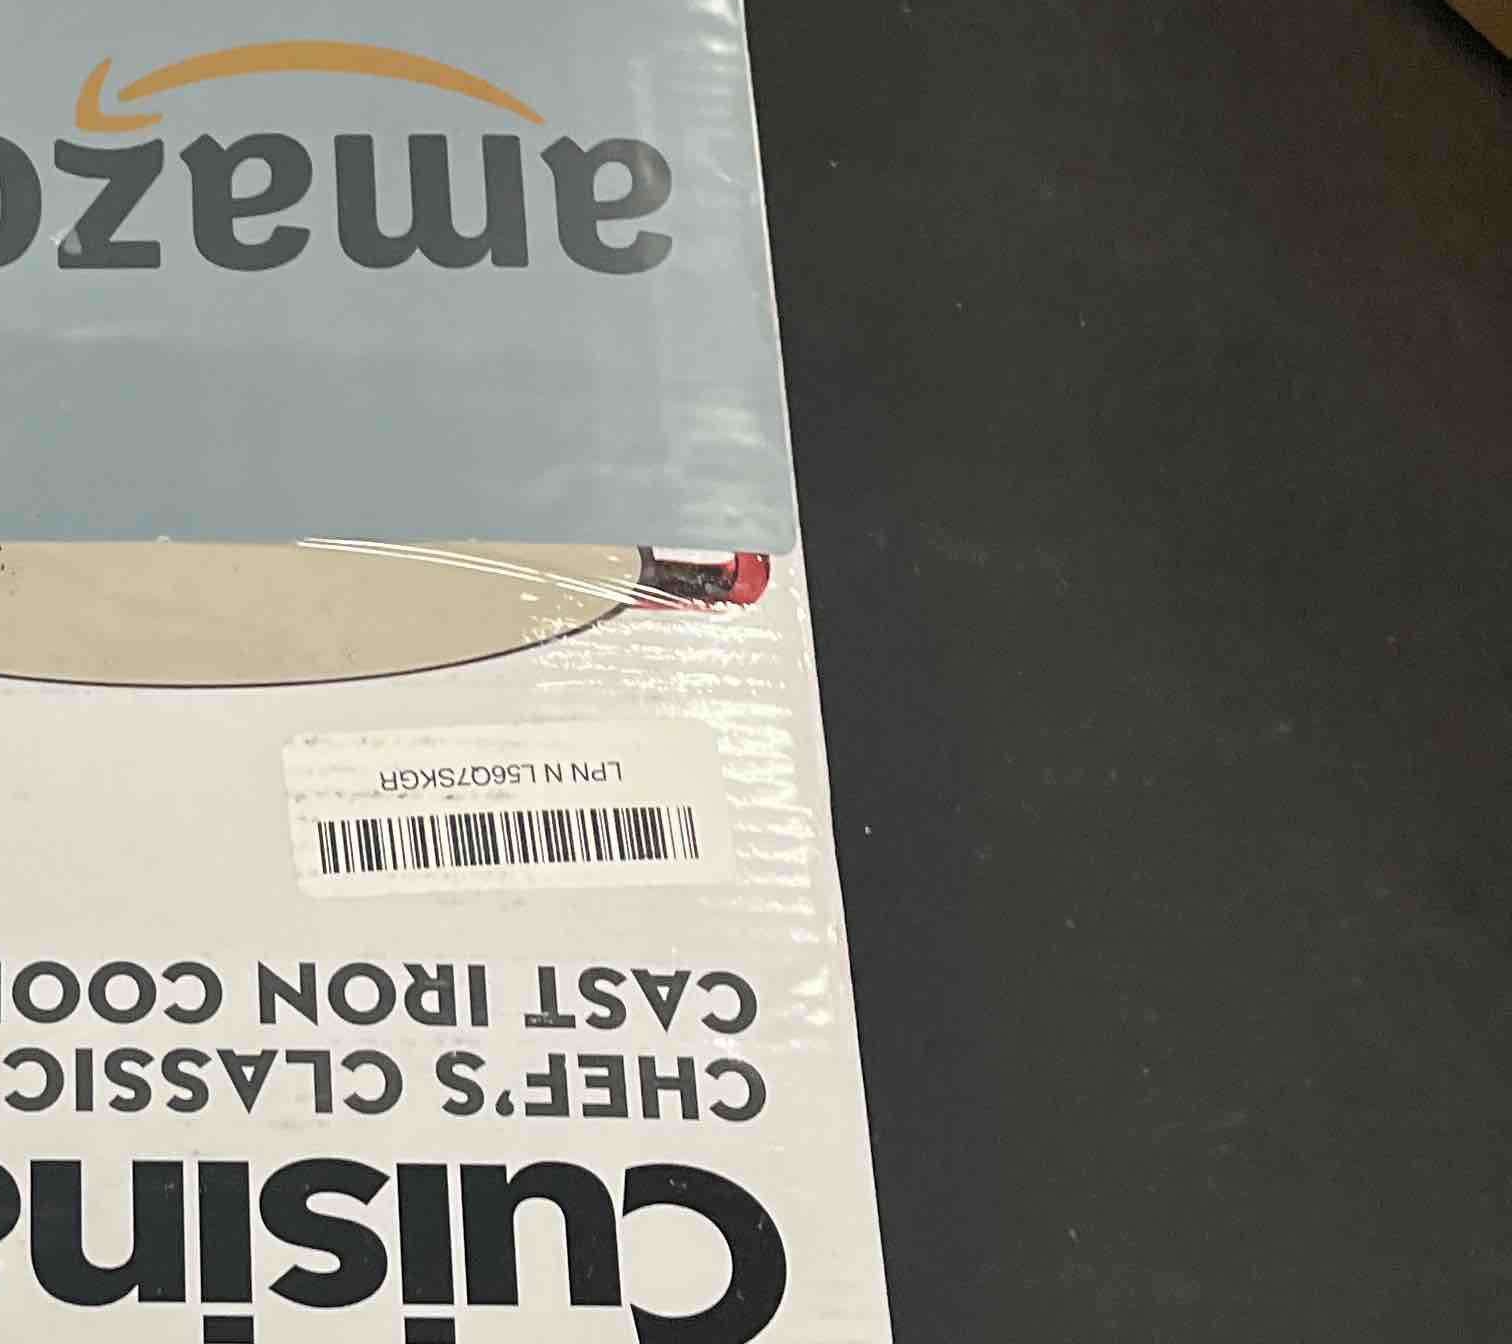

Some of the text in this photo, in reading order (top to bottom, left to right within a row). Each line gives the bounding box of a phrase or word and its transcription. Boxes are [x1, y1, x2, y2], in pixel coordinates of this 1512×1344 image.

[378, 760, 623, 793] LPN N L56Q7SKGR
[255, 961, 489, 1030] IRON
[527, 962, 761, 1038] CAST
